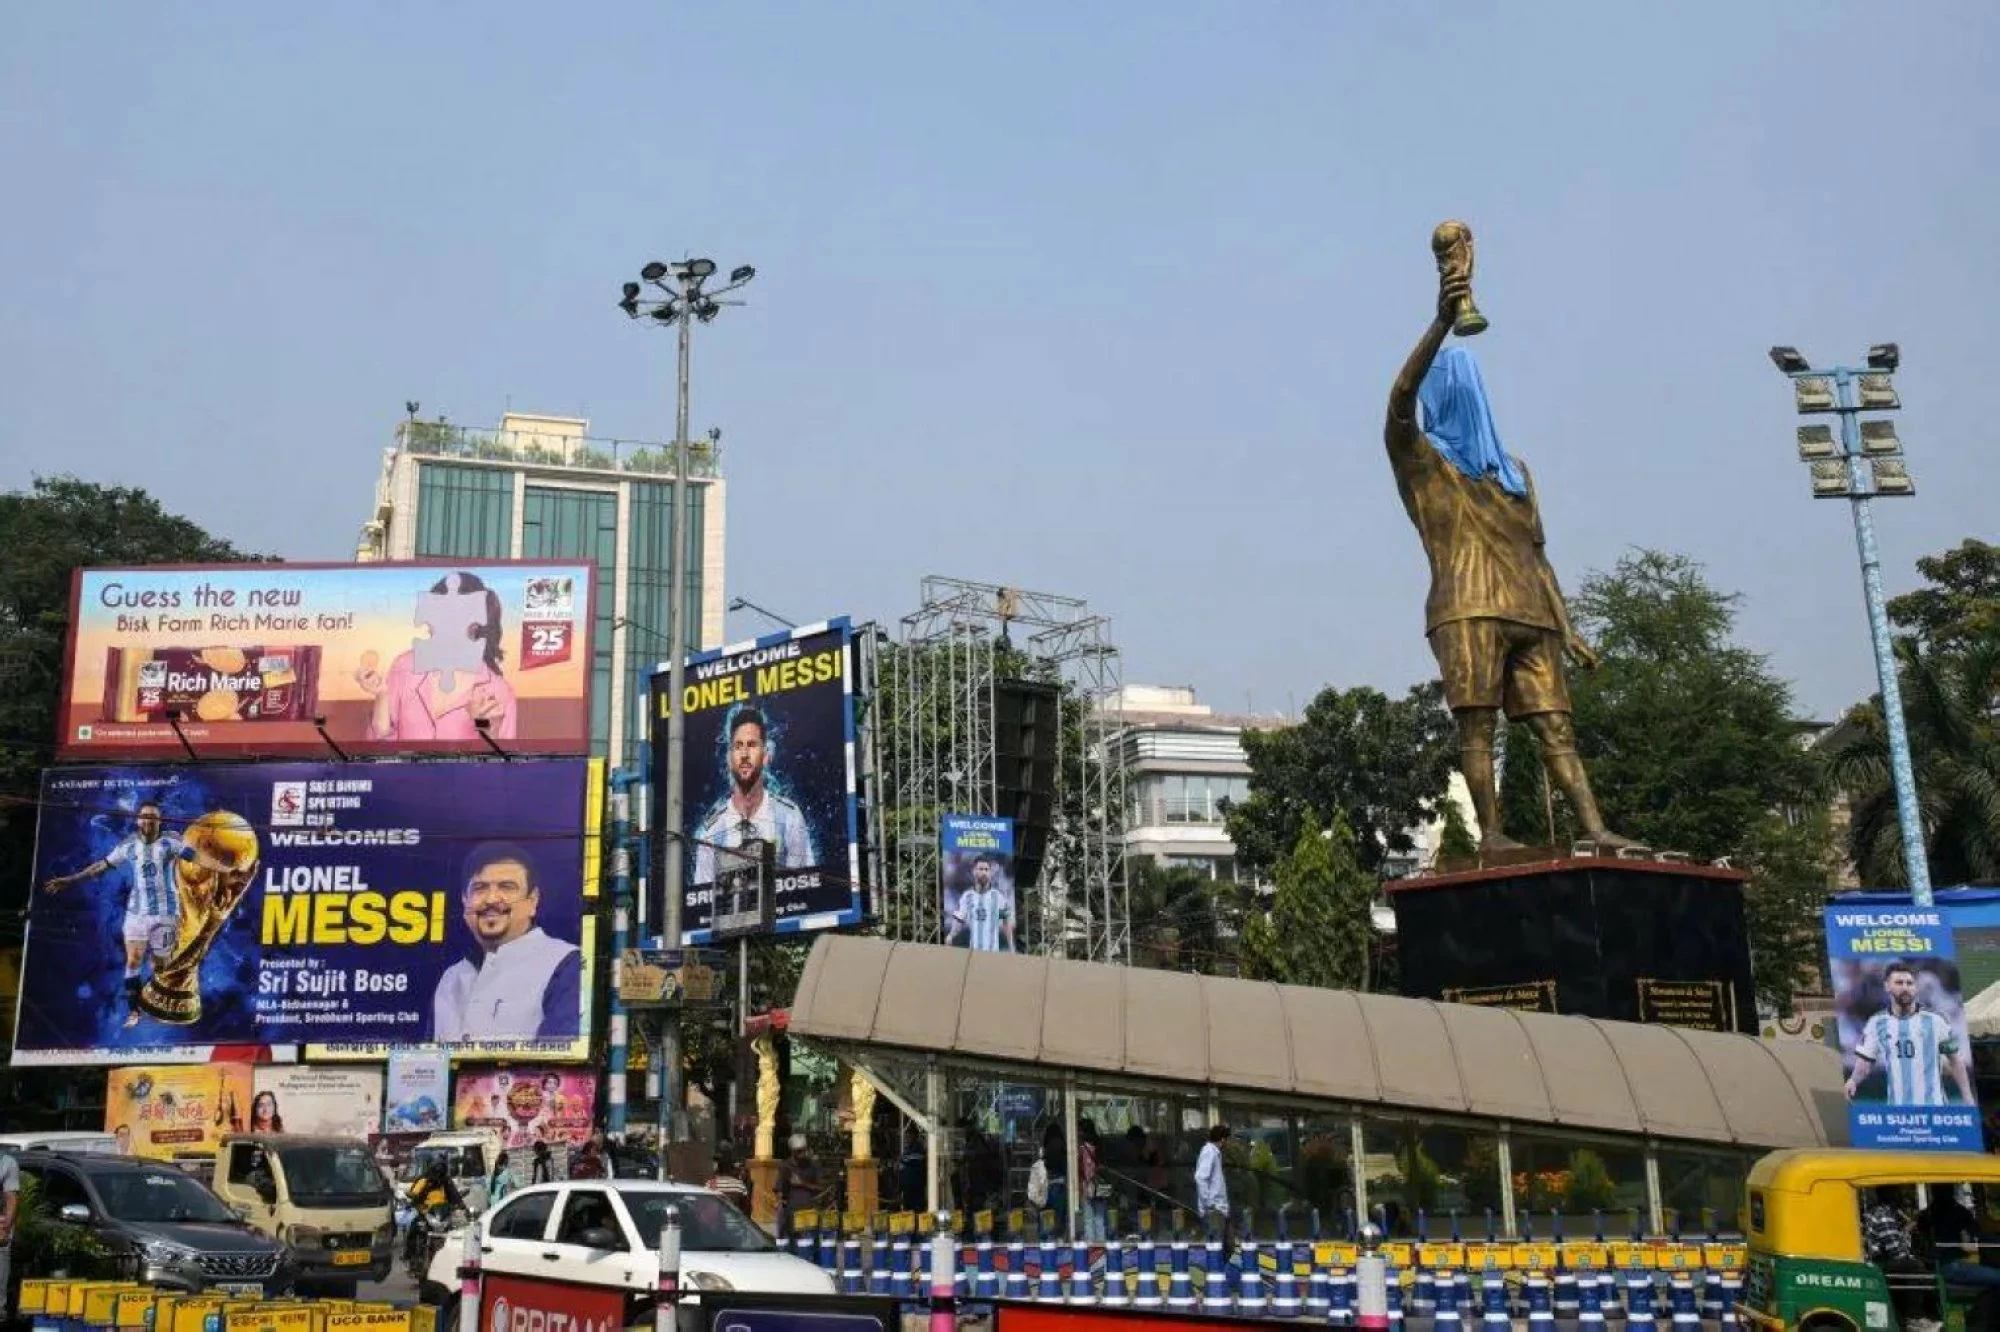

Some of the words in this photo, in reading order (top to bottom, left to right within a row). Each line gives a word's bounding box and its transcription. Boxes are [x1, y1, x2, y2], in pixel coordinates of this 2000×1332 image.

[101, 583, 181, 608] Guess
[194, 583, 236, 607] the
[248, 590, 301, 606] new
[116, 615, 150, 632] Bisk
[158, 615, 203, 632] Farm
[210, 613, 250, 631] Rich
[255, 613, 309, 631] Marie
[317, 611, 353, 631] fan!
[531, 629, 565, 651] 25
[696, 641, 801, 680] WELCOME
[168, 674, 207, 692] Rich
[211, 674, 261, 691] Marie
[659, 675, 750, 719] LONEL
[756, 650, 841, 696] MESSI
[142, 691, 160, 704] 25
[949, 821, 1007, 832] WELCOME
[270, 828, 420, 847] WELCOMES
[265, 866, 369, 892] LIONEL
[262, 891, 446, 945] MESSI
[1835, 914, 1940, 927] WELCOME
[1863, 929, 1916, 937] LIONEL
[1851, 938, 1932, 953] MESSI
[259, 959, 306, 969] Presented
[258, 970, 289, 994] Sri
[295, 970, 347, 998] Sujit
[354, 969, 408, 992] Bose
[355, 1012, 395, 1024] Sporting
[397, 1011, 420, 1021] Club
[1896, 1040, 1915, 1058] 10
[1858, 1114, 1882, 1125] SRI
[1887, 1114, 1928, 1125] SUJIT
[1931, 1115, 1973, 1126] BOSE
[1796, 1273, 1861, 1289] DREAM
[122, 1295, 149, 1303] UCO
[331, 1316, 362, 1326] UCO
[367, 1313, 406, 1324] BANK
